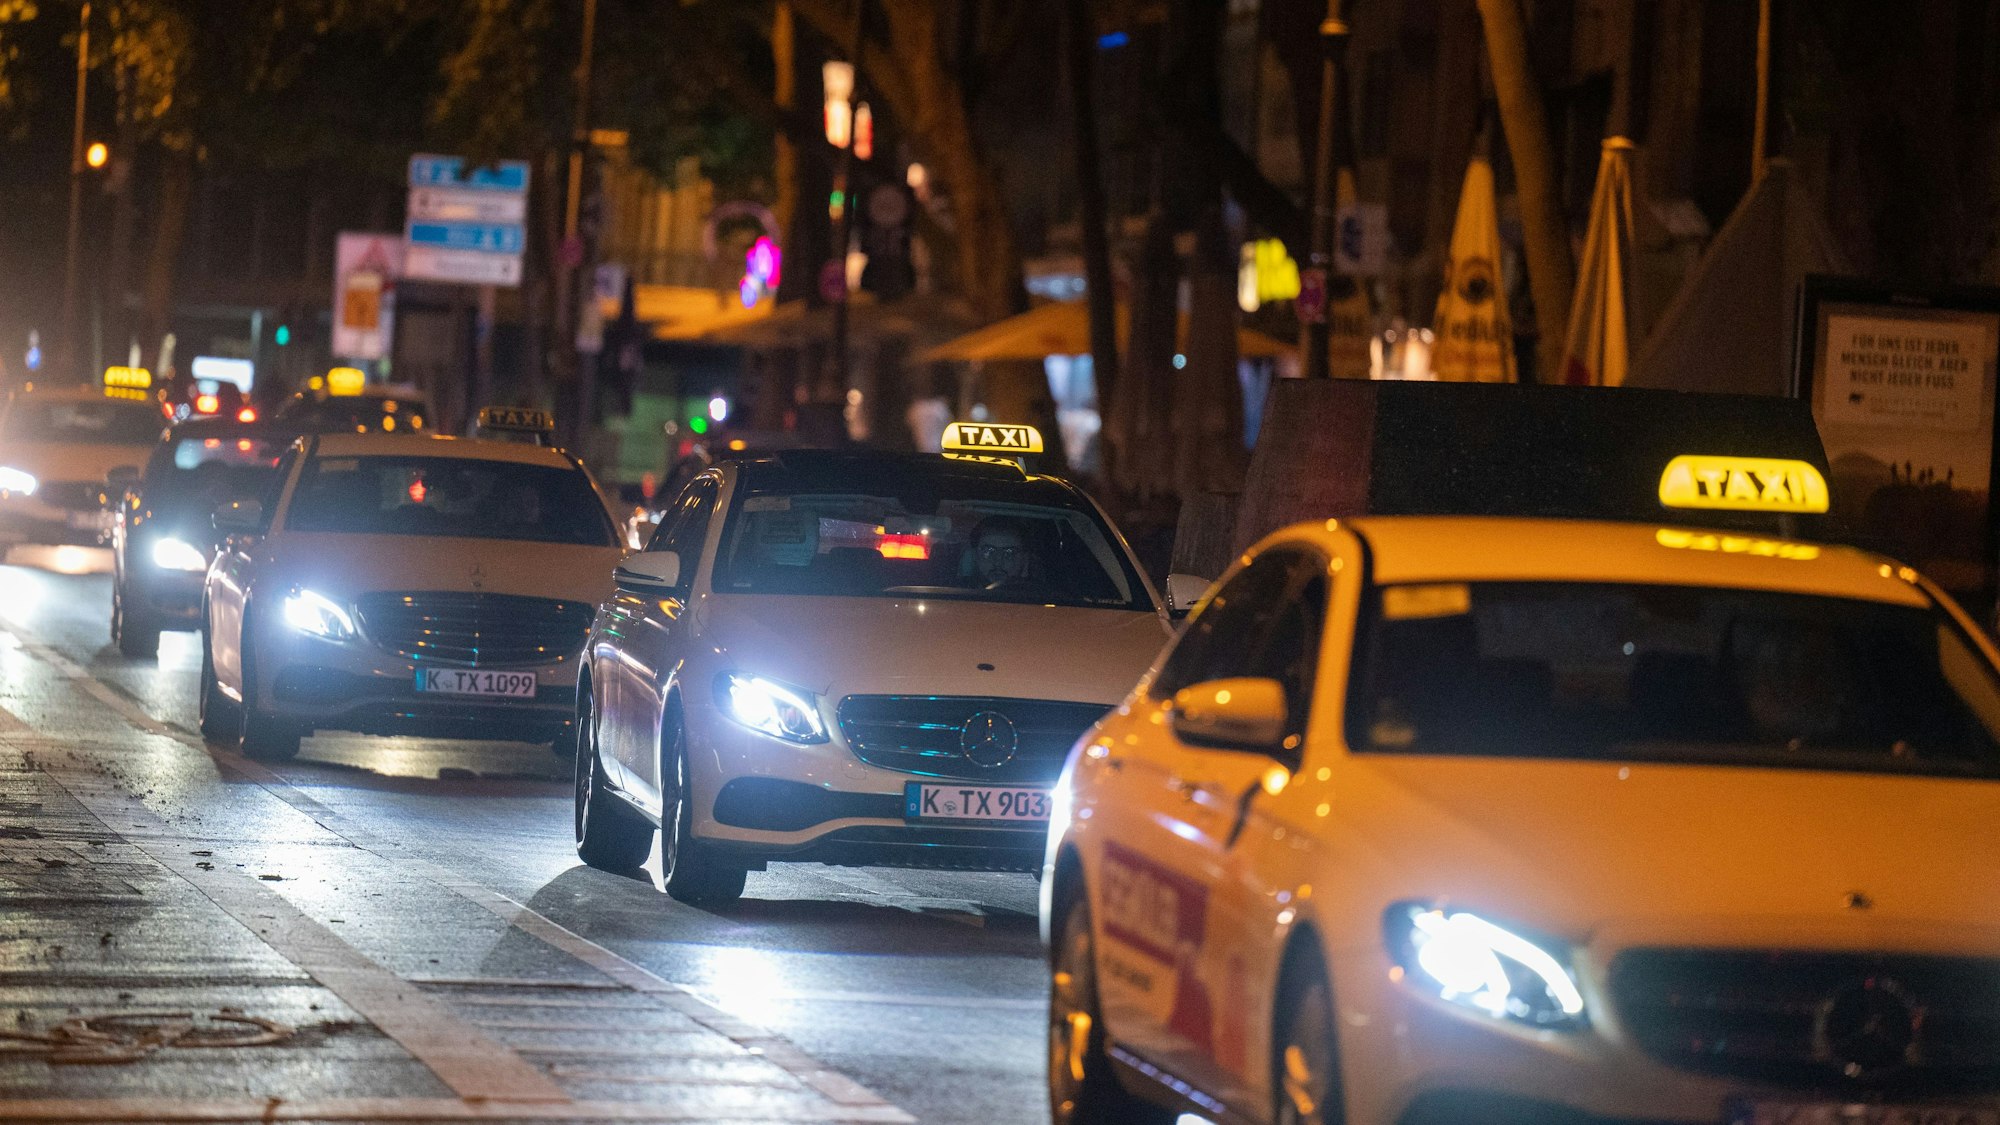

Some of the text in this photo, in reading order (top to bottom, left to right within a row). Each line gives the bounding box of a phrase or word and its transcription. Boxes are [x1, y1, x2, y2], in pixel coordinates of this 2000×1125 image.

[492, 409, 542, 426] TAXI
[960, 426, 1028, 447] TAXI
[1694, 467, 1806, 504] TAXI
[427, 670, 533, 694] K TX 1099
[924, 789, 940, 813] K
[959, 790, 992, 816] TX
